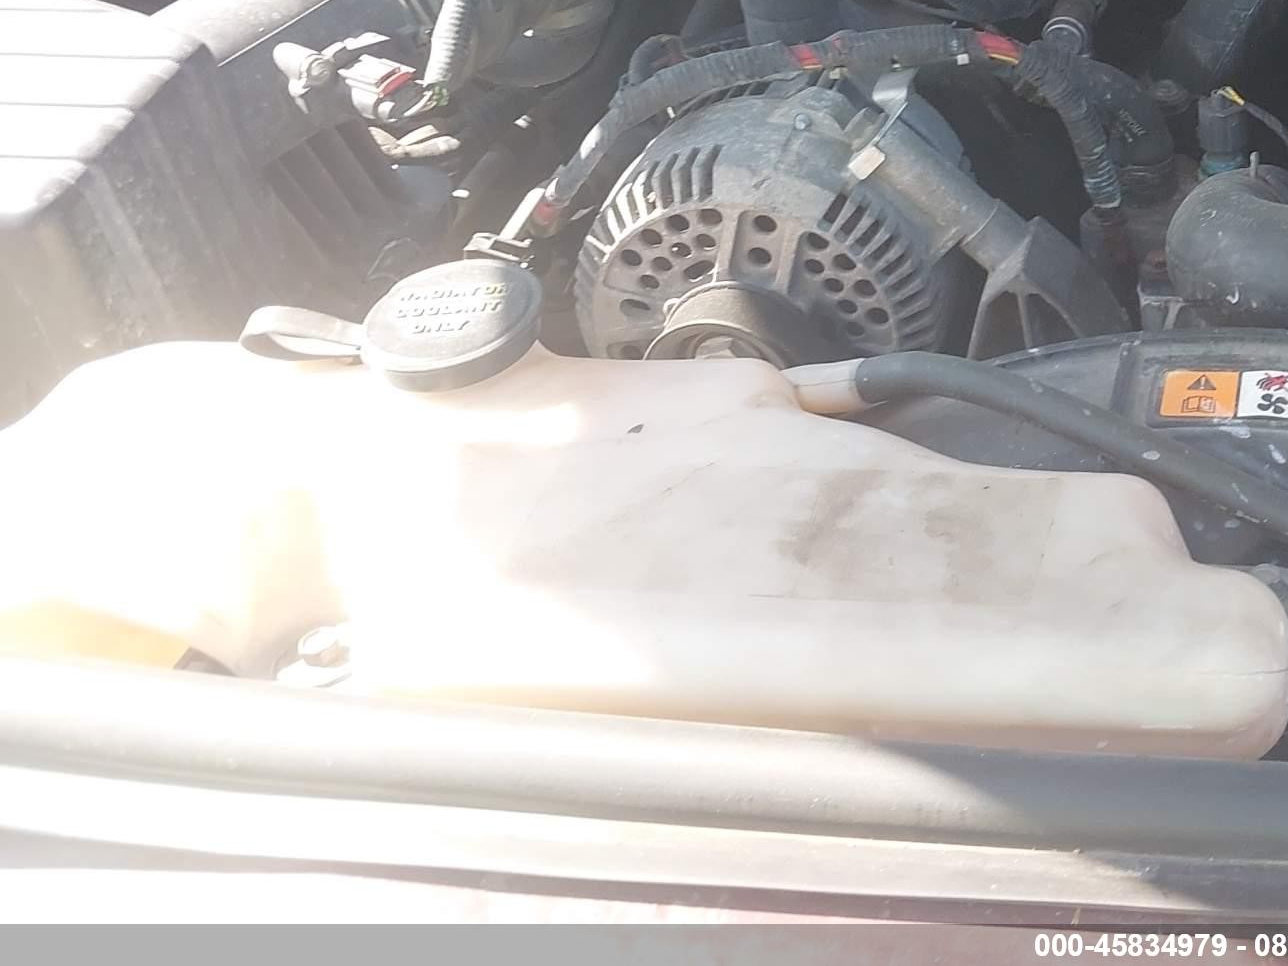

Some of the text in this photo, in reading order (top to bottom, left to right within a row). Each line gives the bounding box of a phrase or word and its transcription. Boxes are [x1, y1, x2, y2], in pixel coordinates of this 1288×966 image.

[399, 282, 509, 302] RADIATOR
[396, 300, 503, 319] COOLANT
[412, 319, 472, 335] ONLY
